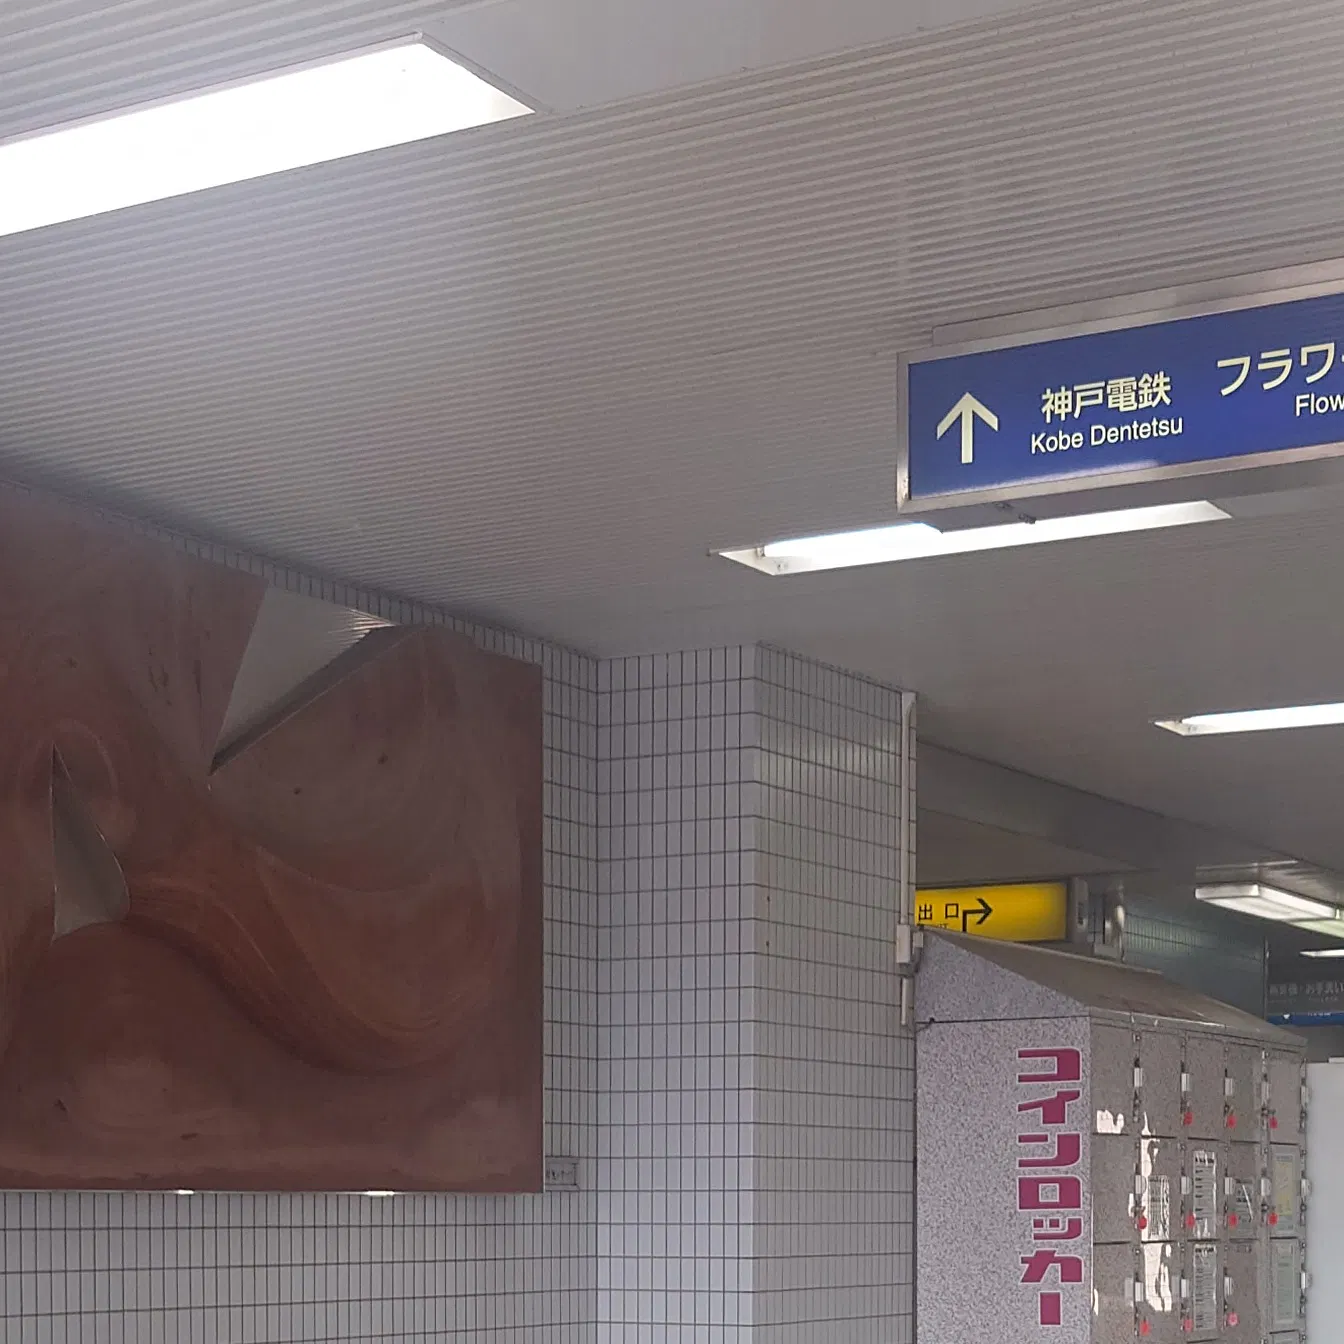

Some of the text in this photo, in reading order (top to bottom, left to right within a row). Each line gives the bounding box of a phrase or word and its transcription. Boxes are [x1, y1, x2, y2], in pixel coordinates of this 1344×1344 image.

[1040, 371, 1172, 424] 神戸電鉄
[1030, 415, 1184, 455] Kobe Dentetsu
[918, 903, 960, 922] 出口
[1016, 1046, 1084, 1327] コインロッカー
